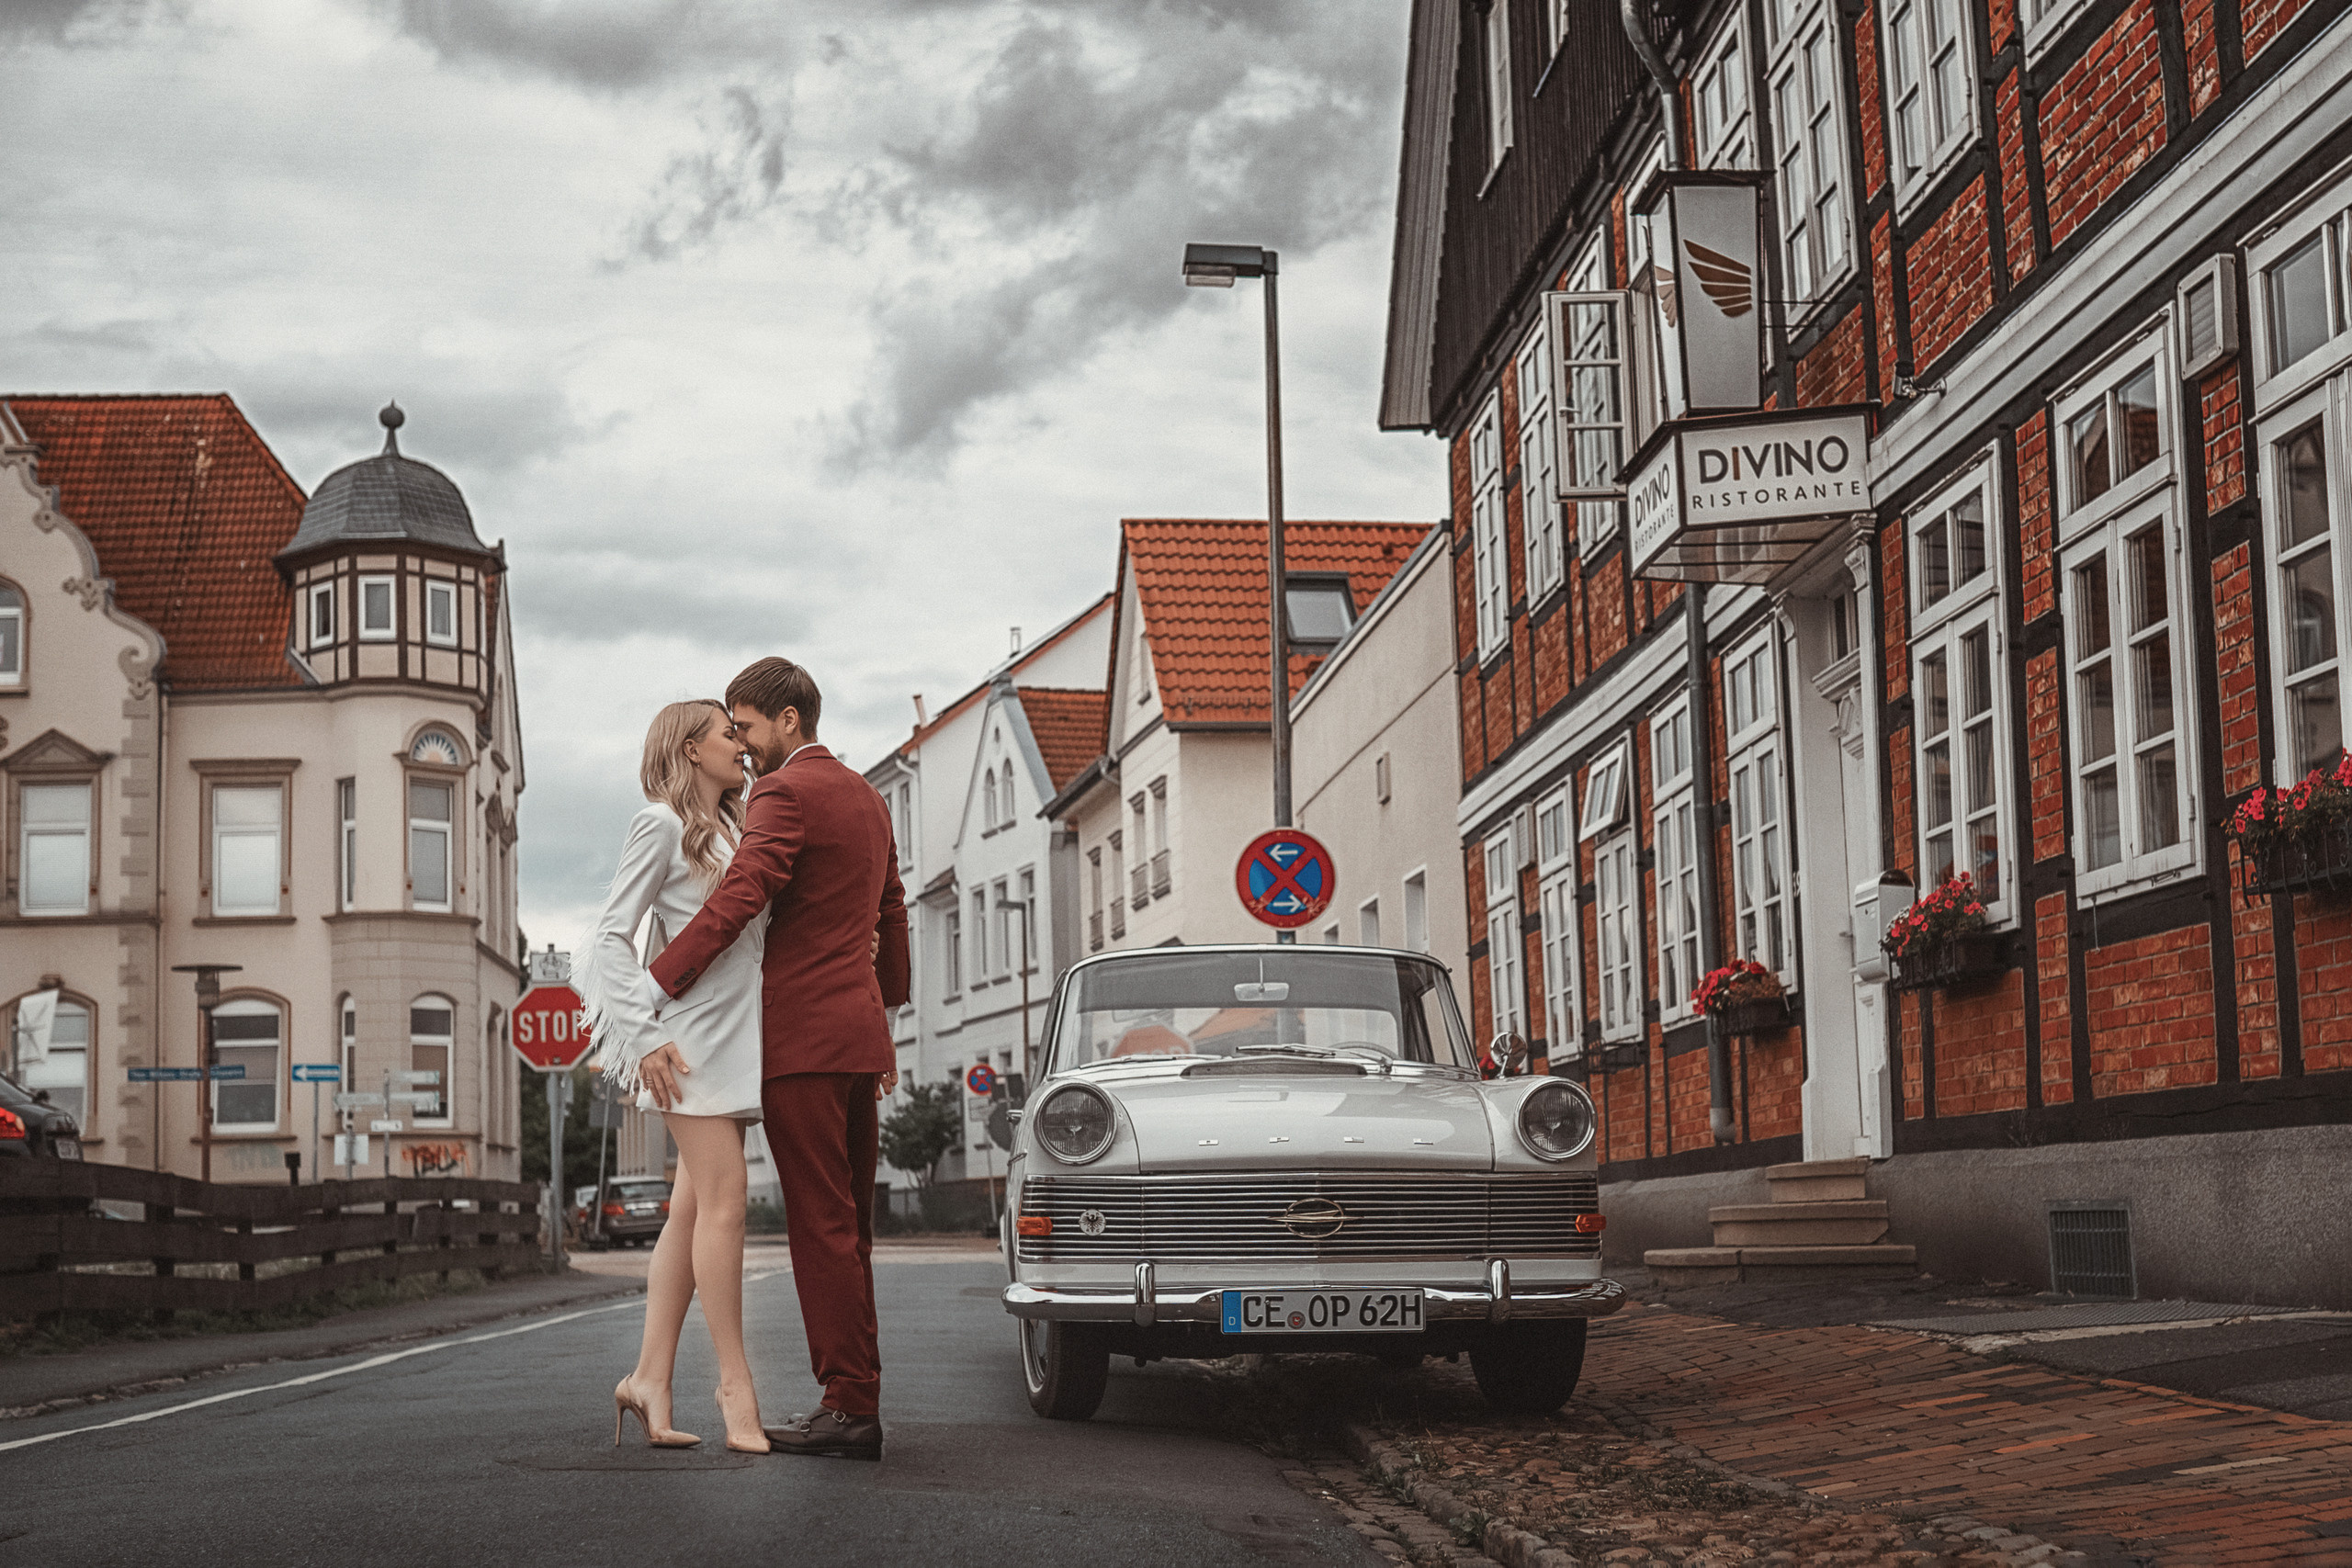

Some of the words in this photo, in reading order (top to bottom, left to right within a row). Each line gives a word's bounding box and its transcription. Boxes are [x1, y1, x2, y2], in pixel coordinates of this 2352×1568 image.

[1698, 435, 1849, 484] DIVINO
[1635, 463, 1670, 528] DIVINO
[1692, 480, 1861, 510] RISTORANTE
[1634, 503, 1674, 552] RISTORANTE
[1243, 1295, 1286, 1328] CE
[1308, 1294, 1351, 1327] OP
[1359, 1293, 1421, 1327] 62H
